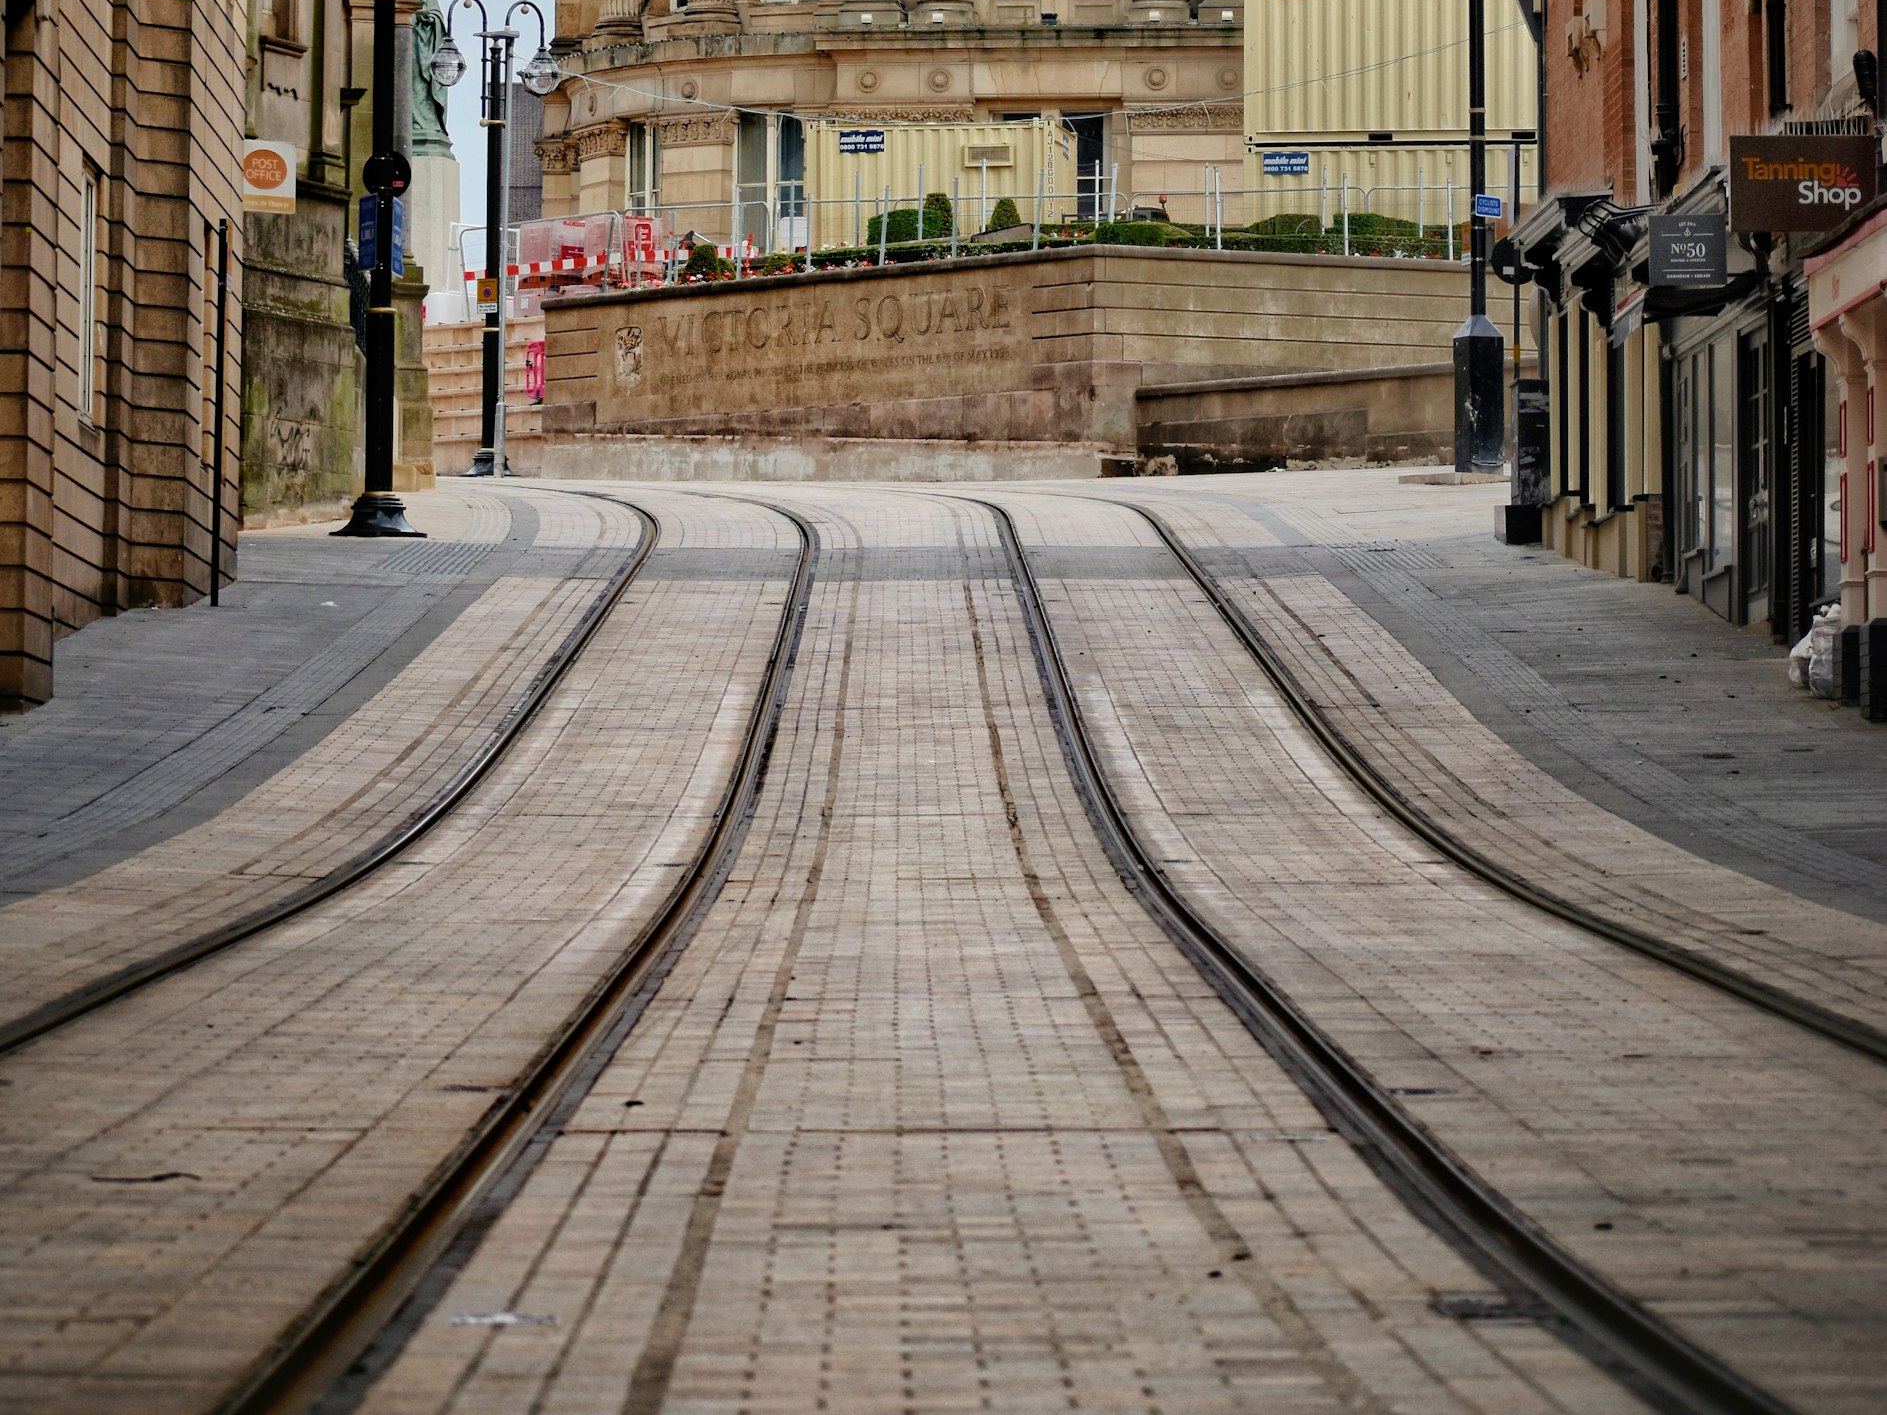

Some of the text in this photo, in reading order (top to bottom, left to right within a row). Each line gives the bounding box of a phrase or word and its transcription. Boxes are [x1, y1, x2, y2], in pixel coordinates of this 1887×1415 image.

[840, 135, 884, 143] mobile mini
[252, 158, 278, 170] POST
[1263, 156, 1307, 165] mobile mini
[246, 168, 282, 181] OFFICE
[1741, 157, 1836, 186] Tanning
[1798, 180, 1862, 211] Shop
[1477, 205, 1500, 216] DISMOUNT
[658, 285, 1010, 357] VICTORIA SQUARE
